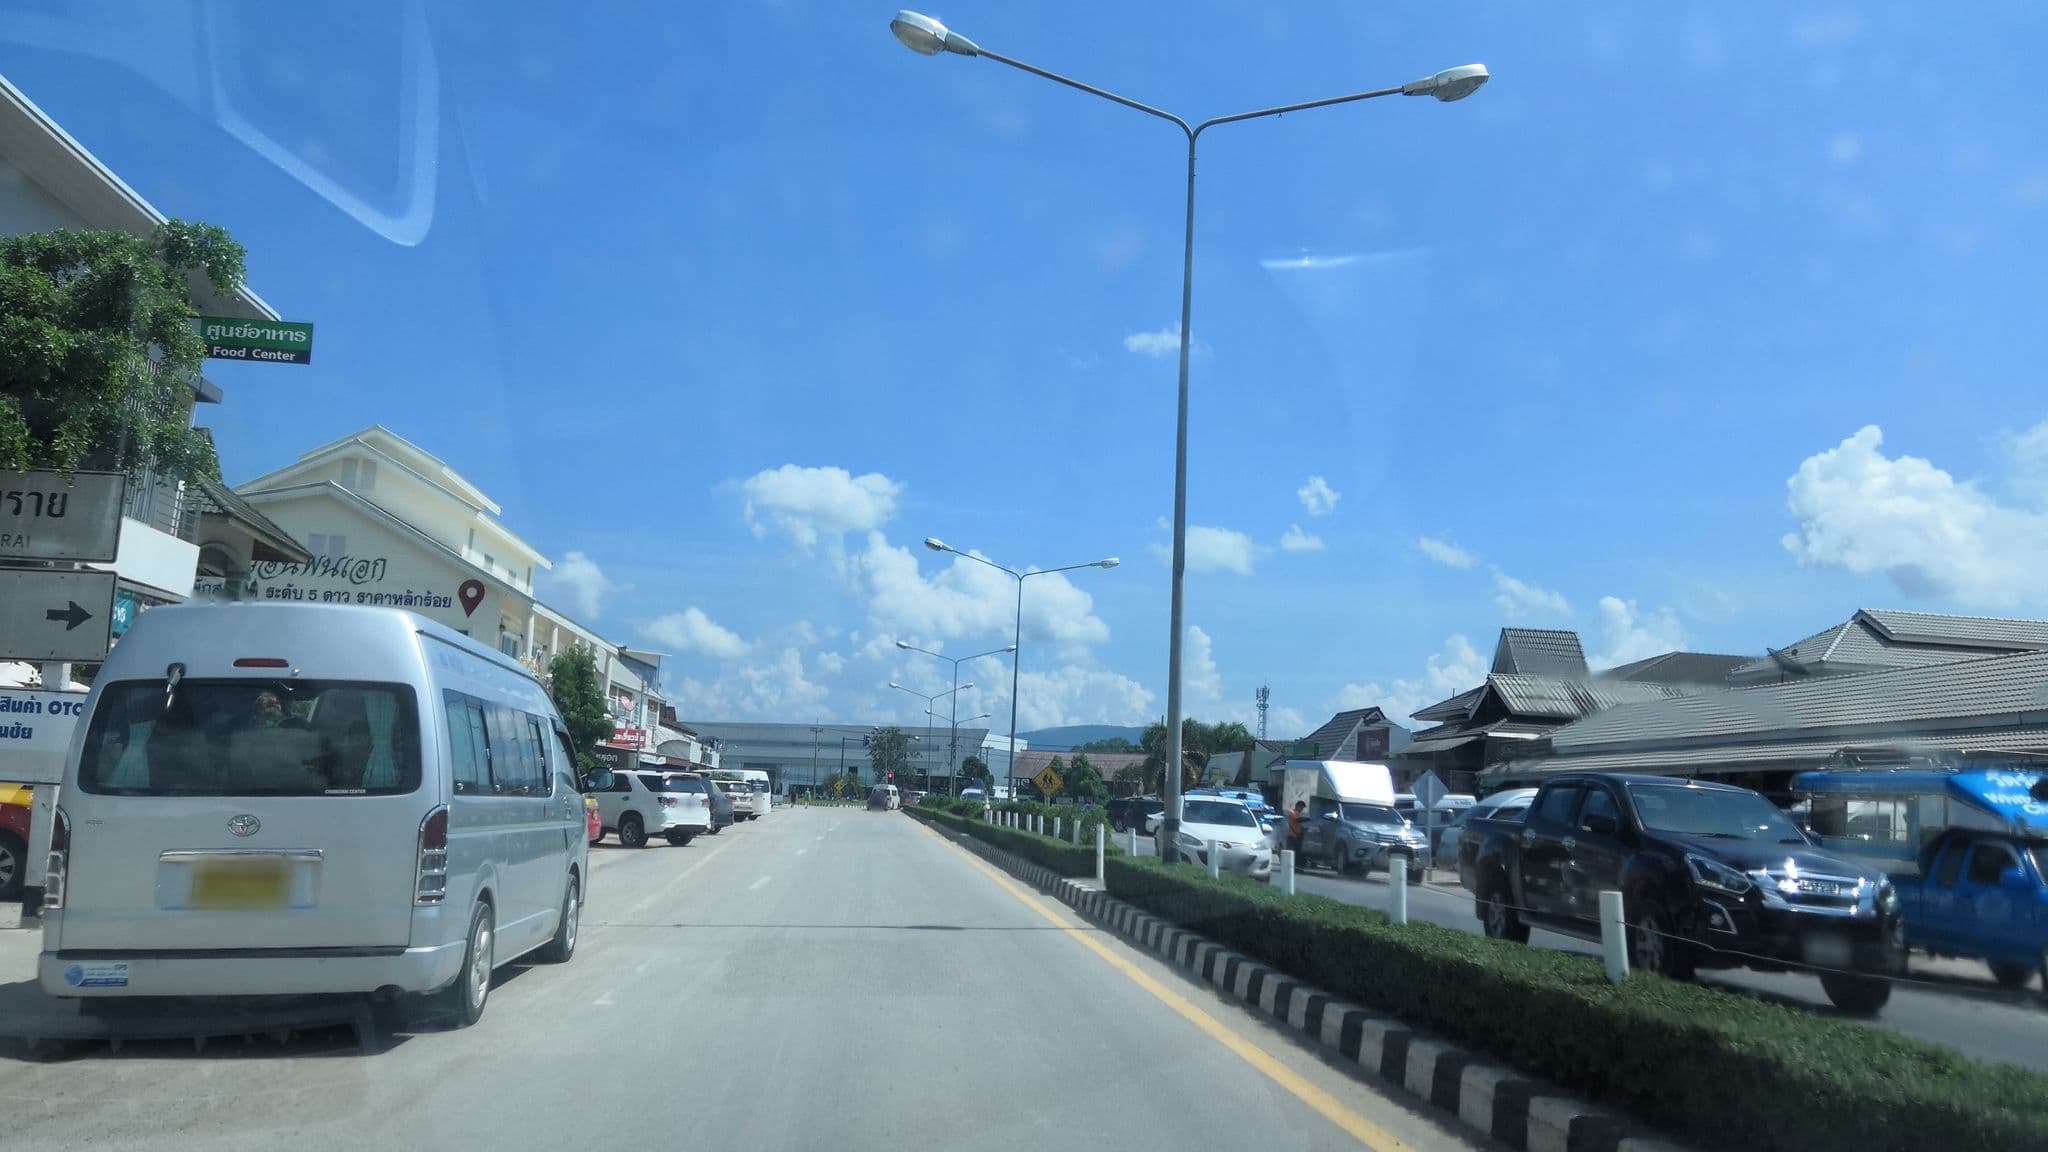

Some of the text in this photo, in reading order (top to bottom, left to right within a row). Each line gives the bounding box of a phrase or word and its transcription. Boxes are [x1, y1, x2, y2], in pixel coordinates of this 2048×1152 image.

[206, 323, 307, 342] ศูนย์อาหาร
[213, 346, 296, 361] Food Center
[0, 491, 68, 518] ราย
[1, 534, 31, 548] RAI
[265, 584, 303, 601] ระดับ
[308, 589, 318, 601] 5
[323, 590, 351, 603] ดาว
[357, 589, 452, 608] ราคาหลักร้อย
